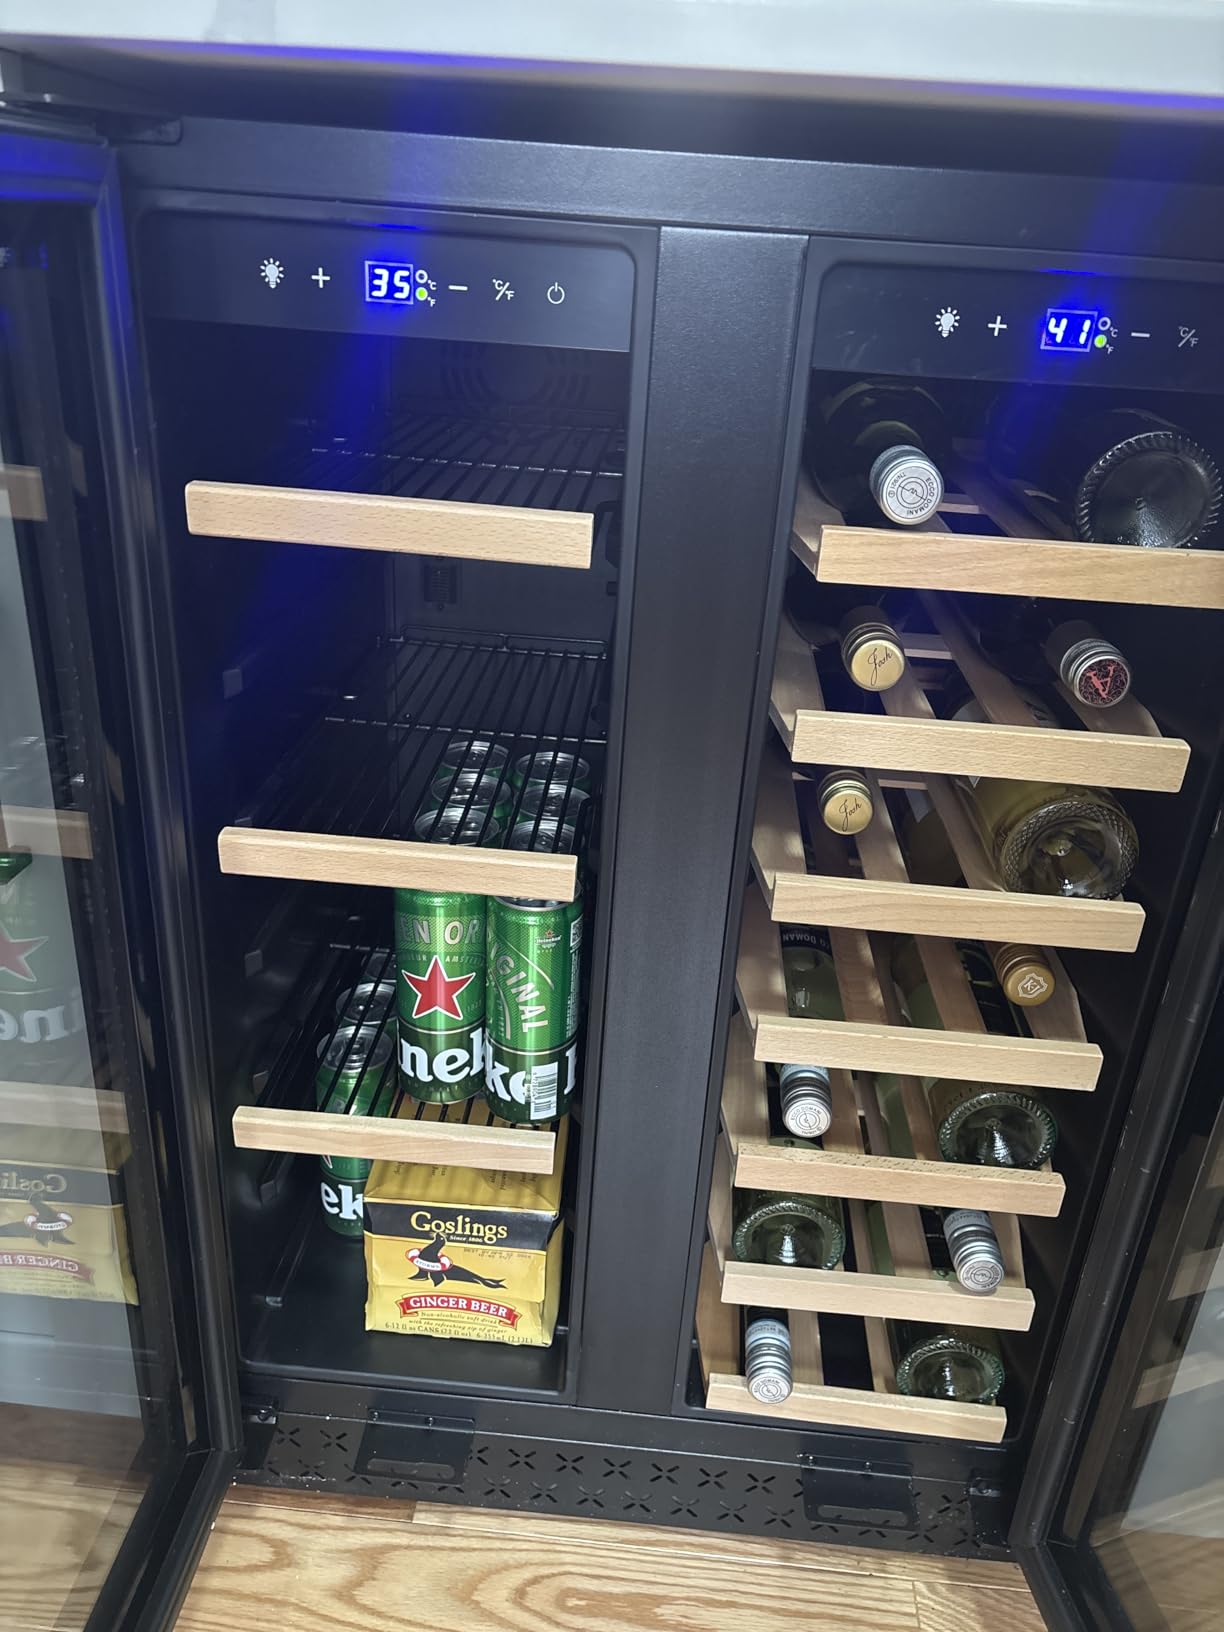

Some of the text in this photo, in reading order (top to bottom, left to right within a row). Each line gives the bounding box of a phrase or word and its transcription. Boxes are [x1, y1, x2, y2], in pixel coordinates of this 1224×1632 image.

[371, 268, 410, 299] 35
[1048, 317, 1091, 345] 41
[906, 477, 935, 516] ECCO DOMANI
[410, 1210, 508, 1245] Goslings
[409, 1296, 508, 1317] GINGER BEER
[417, 1325, 439, 1333] CANS
